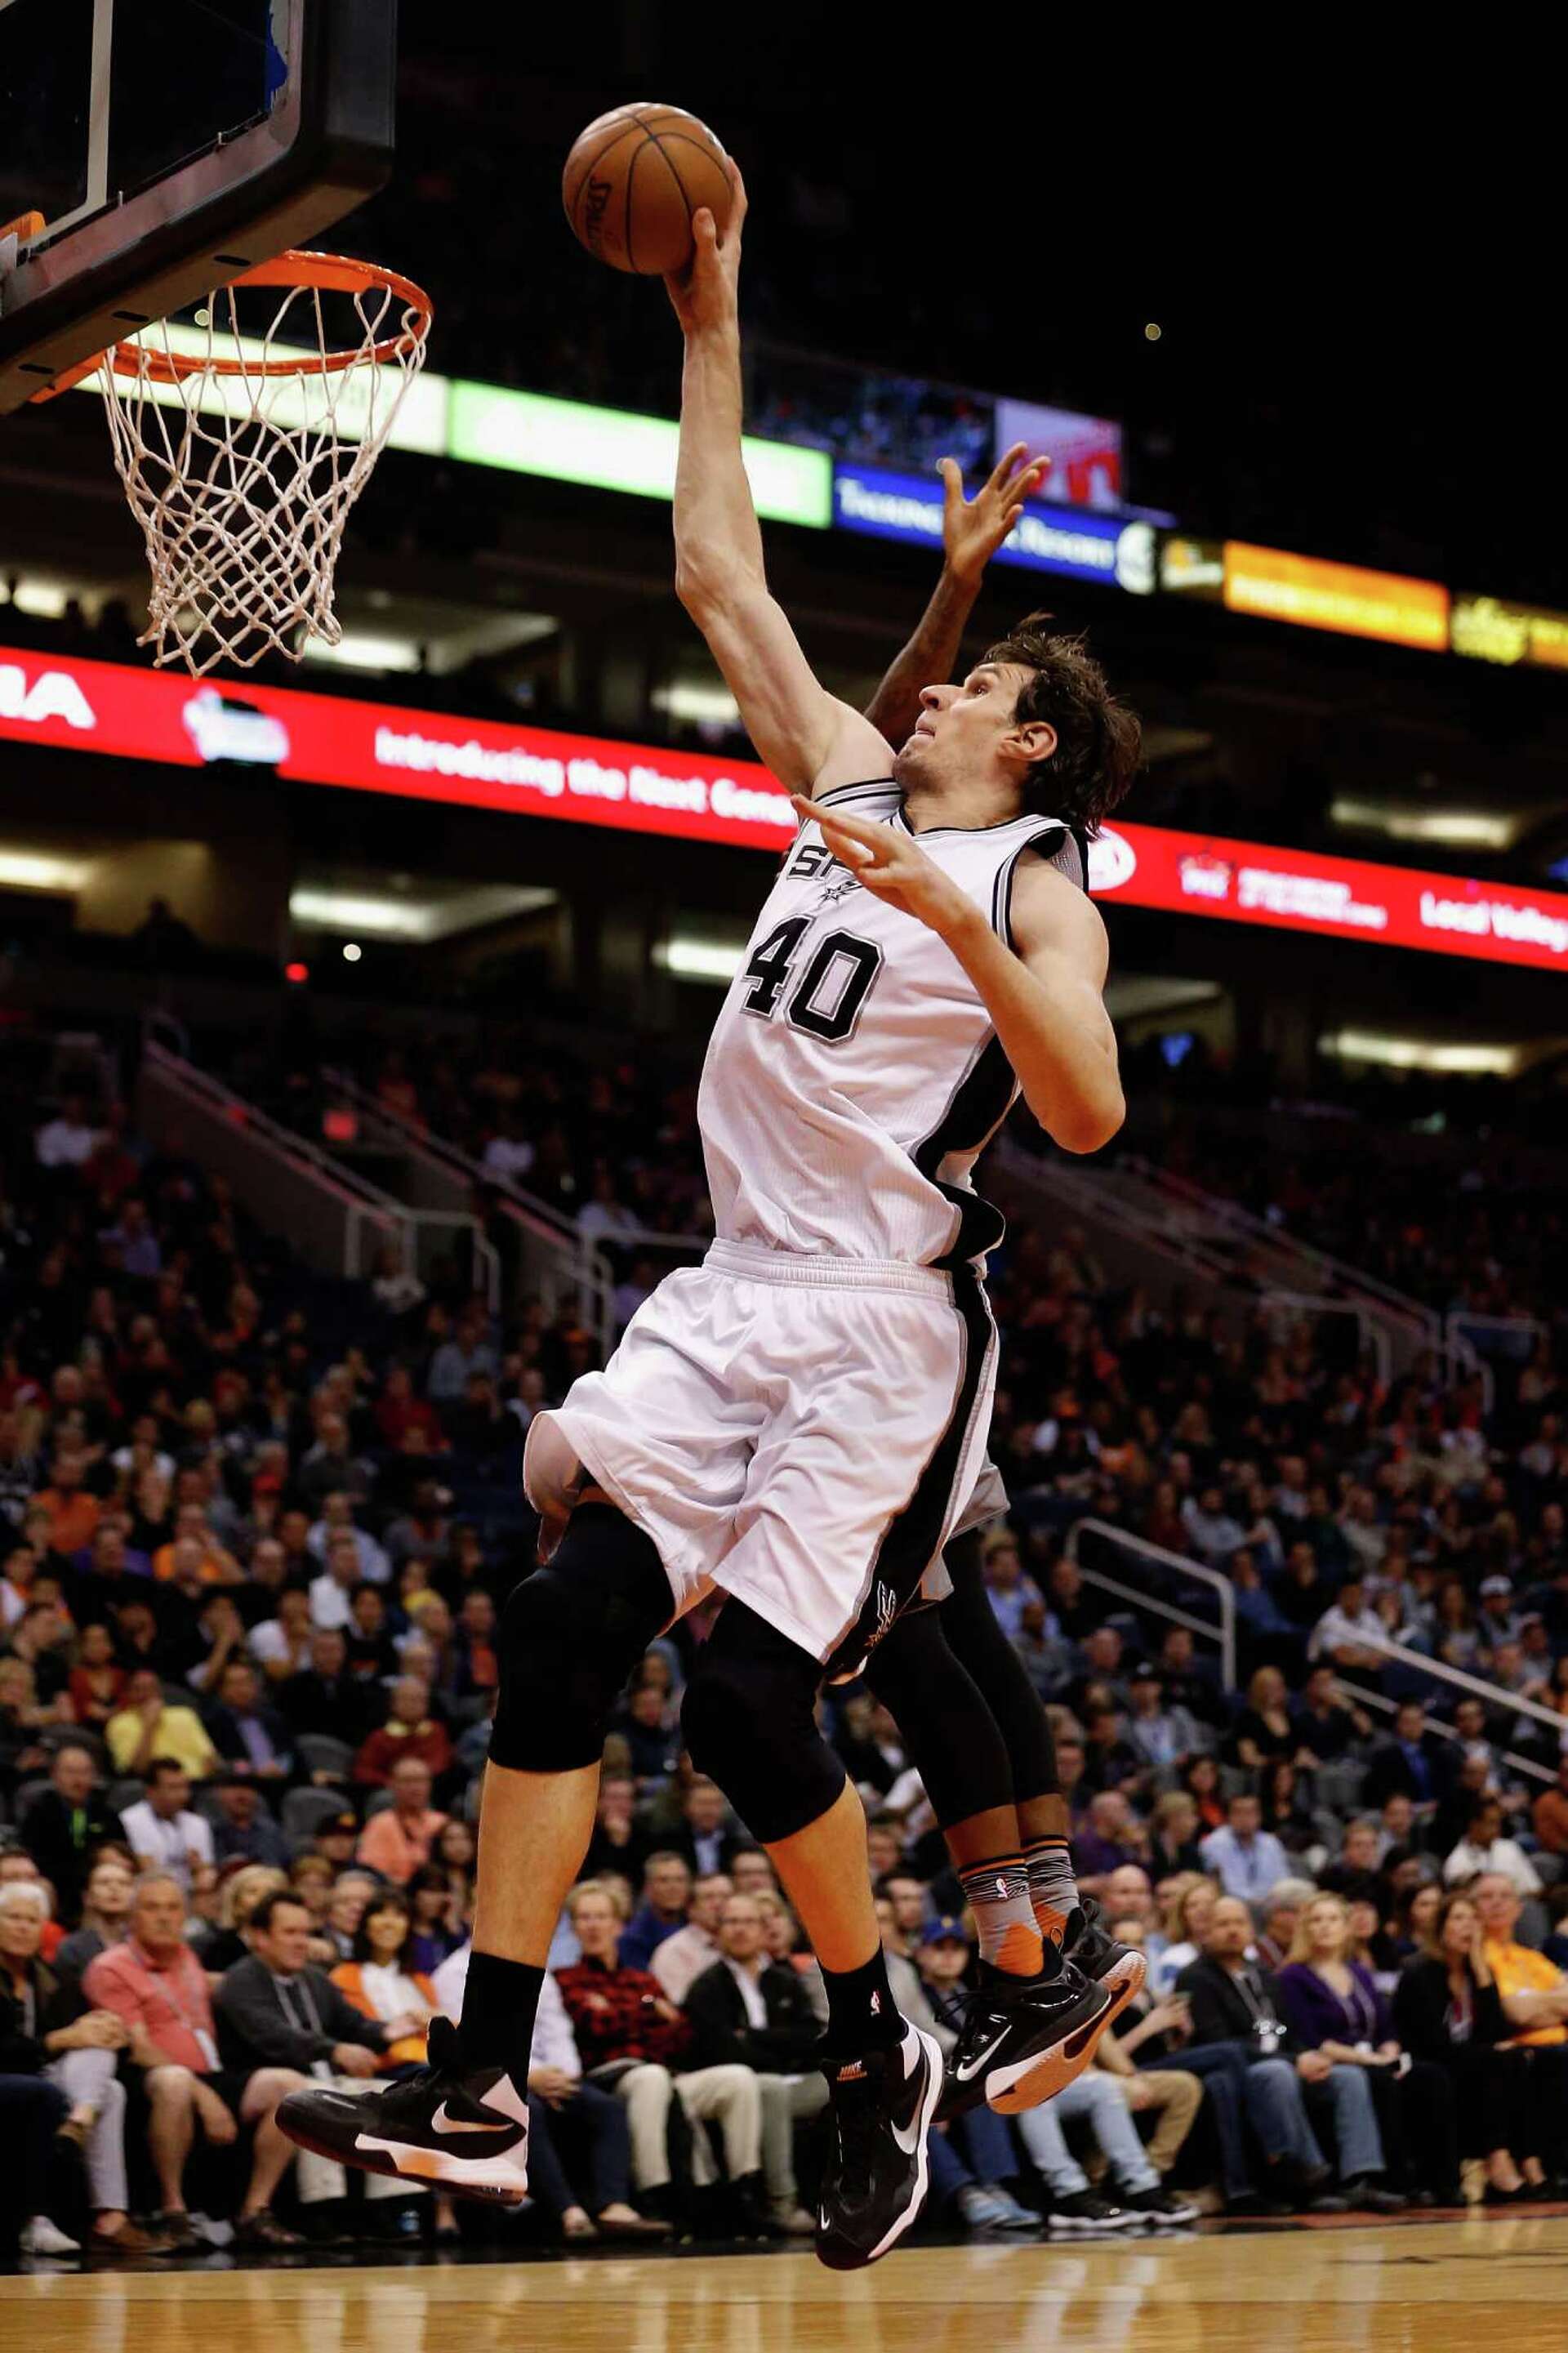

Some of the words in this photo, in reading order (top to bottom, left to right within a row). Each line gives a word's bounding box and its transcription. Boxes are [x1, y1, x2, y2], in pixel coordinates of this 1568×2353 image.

[376, 728, 564, 795] Introducing
[568, 759, 626, 800] the
[741, 912, 885, 1047] 40
